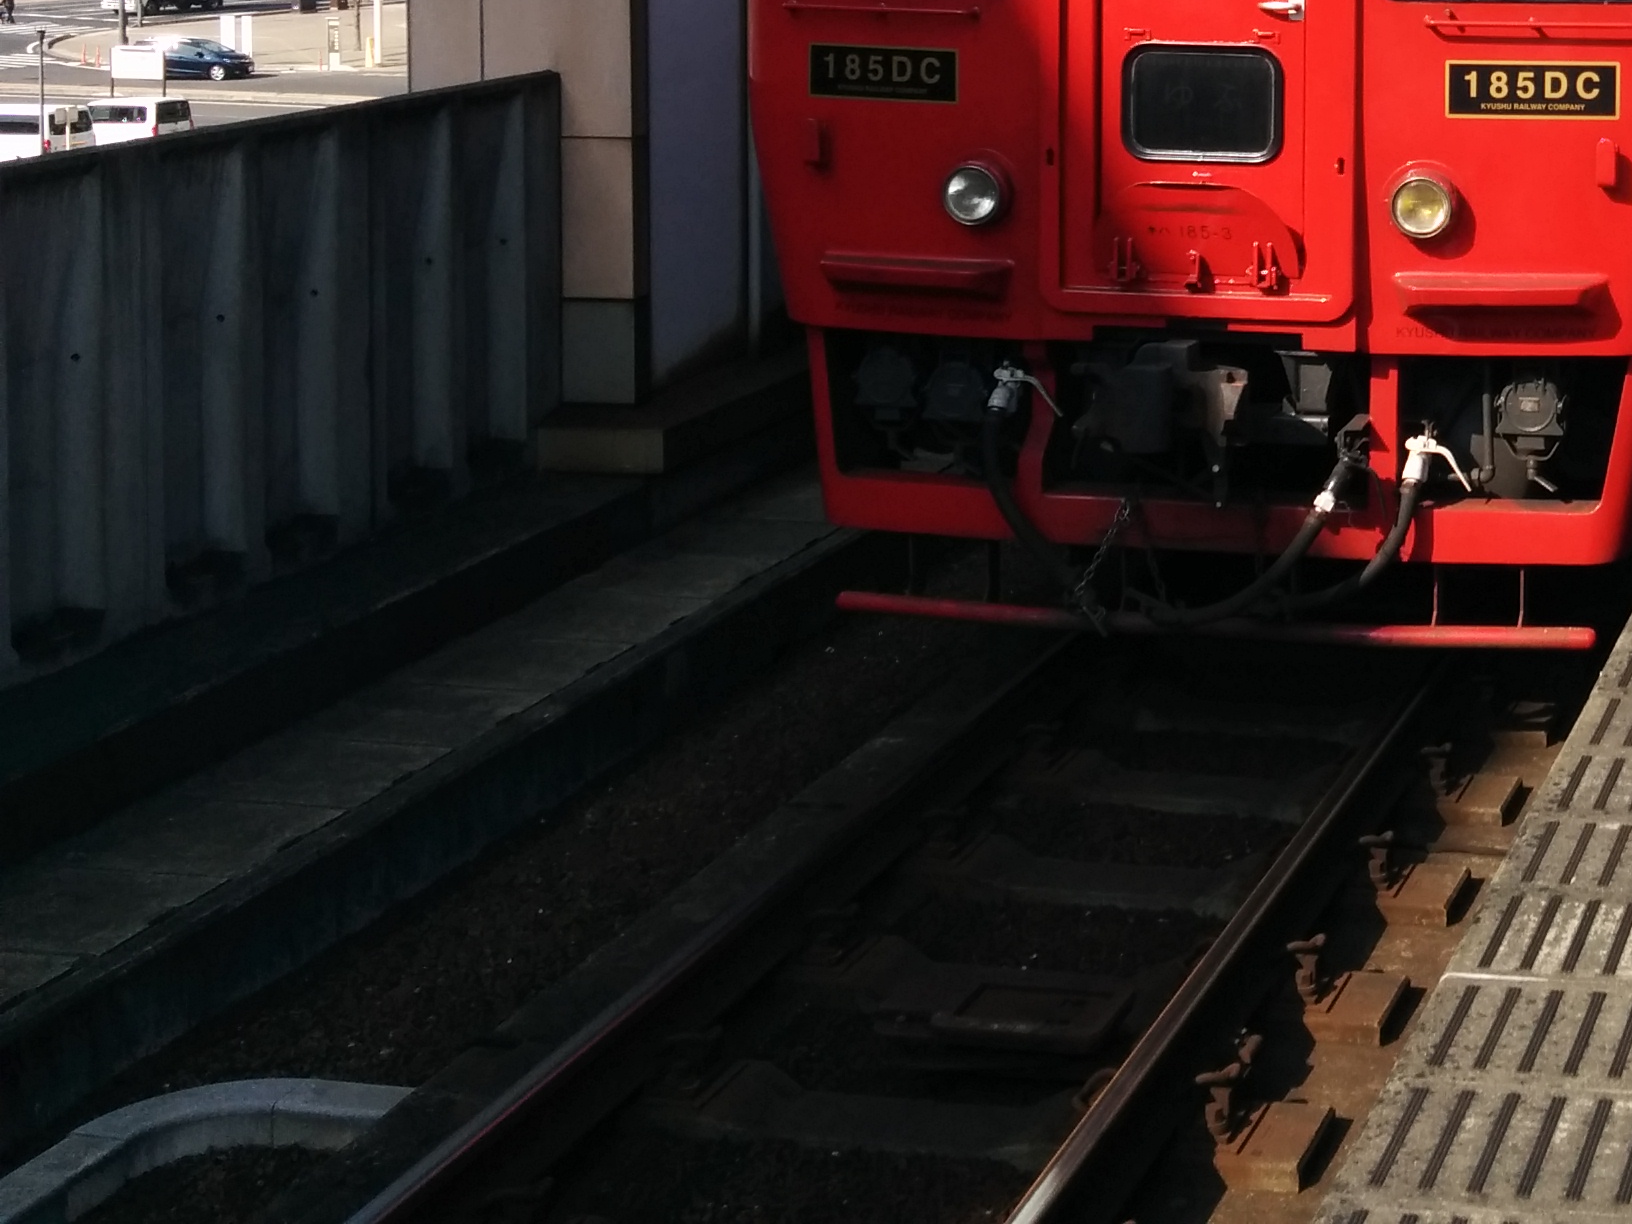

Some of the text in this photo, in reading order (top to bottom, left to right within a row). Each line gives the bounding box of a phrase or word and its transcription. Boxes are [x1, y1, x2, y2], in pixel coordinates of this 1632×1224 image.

[823, 52, 942, 85] 185DC
[1464, 70, 1600, 100] 185DC
[1480, 102, 1586, 112] KYUSHU RAILWAY COMPANY
